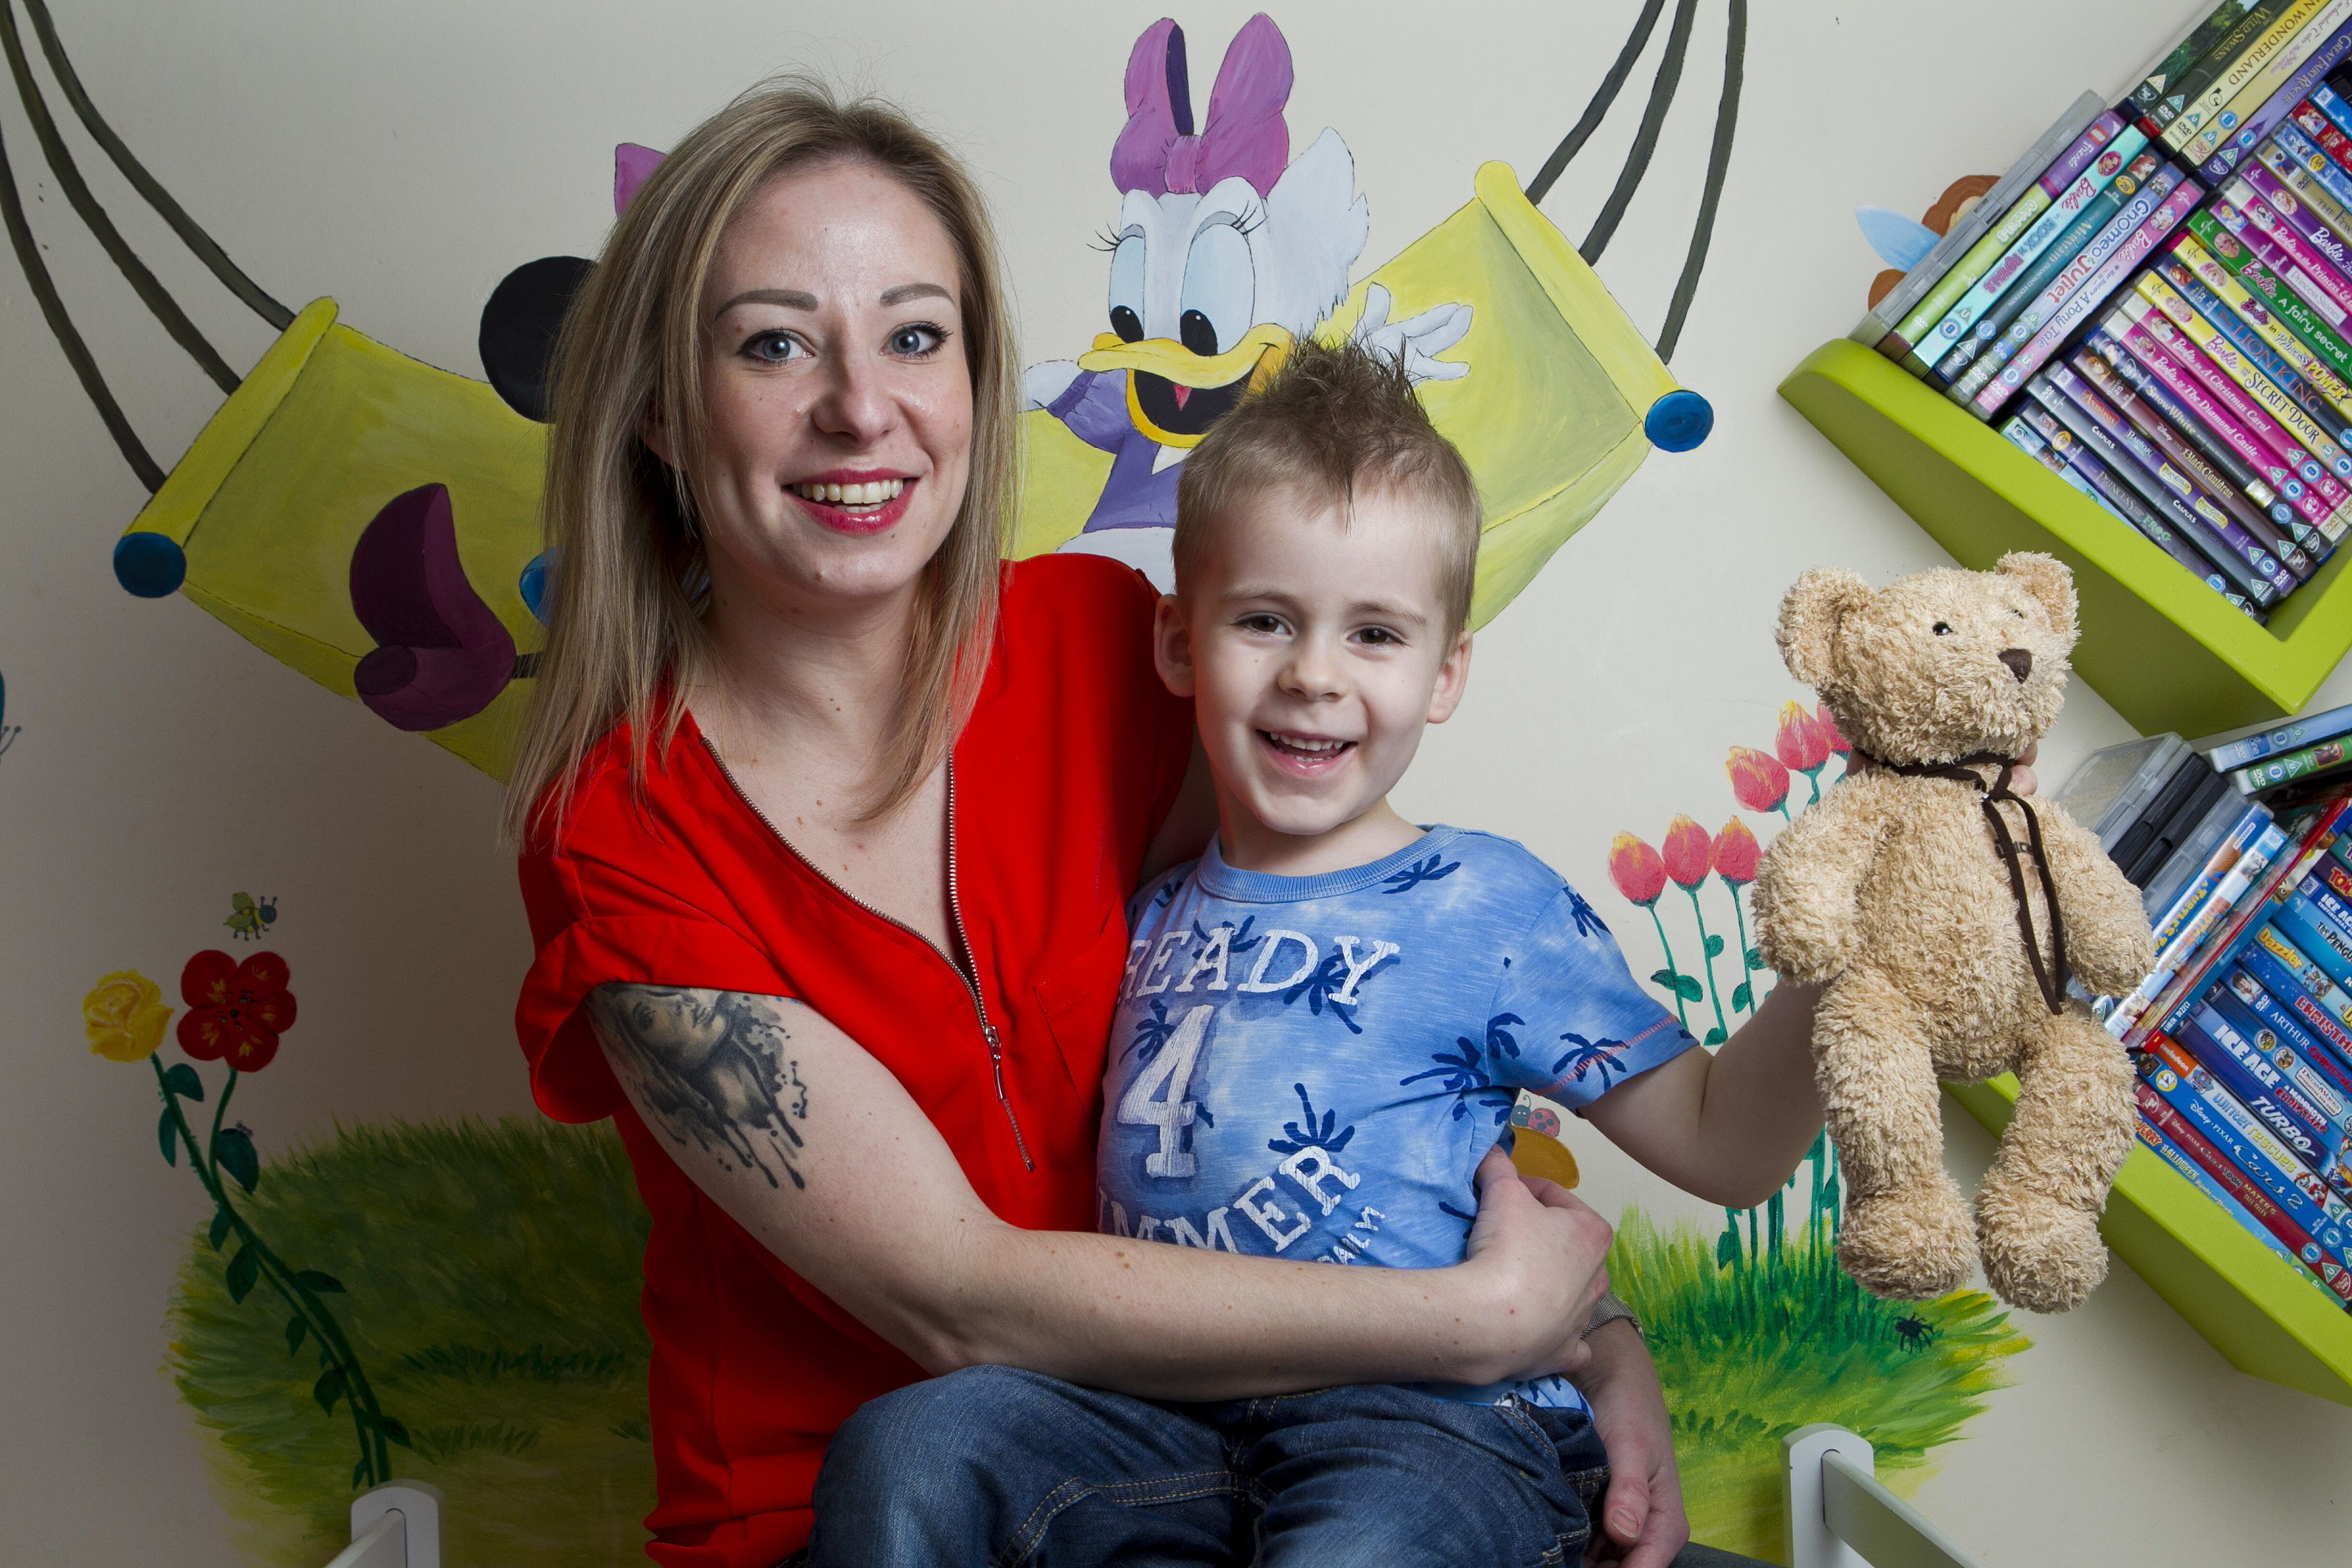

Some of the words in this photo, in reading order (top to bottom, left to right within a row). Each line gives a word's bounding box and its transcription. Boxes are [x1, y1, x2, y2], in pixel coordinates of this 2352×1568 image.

[2239, 4, 2270, 34] WILD
[2211, 29, 2245, 62] SWANS
[2228, 9, 2304, 86] WONDERLAND
[2090, 128, 2105, 142] LEGO
[2065, 140, 2094, 169] Friends
[2059, 178, 2096, 215] Barbie
[2120, 181, 2130, 191] 28
[2295, 174, 2308, 188] DVD
[2316, 199, 2334, 216] THE
[2023, 218, 2056, 250] ROCK
[2047, 219, 2091, 264] MERMAID
[2115, 229, 2152, 266] Barbie
[2310, 226, 2348, 264] Barbie
[1982, 252, 2023, 293] ROYALS
[2025, 262, 2051, 287] DIAMOND
[2274, 226, 2300, 252] Barbie
[2310, 263, 2341, 293] Princess
[2339, 290, 2351, 302] &
[2007, 285, 2028, 306] EDITION
[2054, 299, 2083, 328] Pony
[2079, 292, 2091, 304] A
[2197, 292, 2206, 301] 32
[2242, 258, 2283, 298] Barbie
[2278, 296, 2289, 307] A
[2286, 303, 2316, 333] fairy
[2314, 329, 2348, 363] secret
[2290, 270, 2319, 299] Princess
[2316, 295, 2341, 320] Stories
[2035, 324, 2060, 349] Tale
[2242, 298, 2272, 327] Barbie
[2274, 331, 2310, 367] Princess
[2306, 360, 2347, 401] POWER
[2172, 338, 2199, 364] Barbie
[2202, 367, 2212, 376] A
[2209, 373, 2248, 412] Christmas
[2246, 409, 2271, 433] Carol
[2231, 325, 2277, 369] LION
[2275, 366, 2322, 412] KING
[2040, 385, 2053, 398] DVD
[2114, 385, 2123, 395] 25
[2154, 355, 2180, 381] Barbie
[2184, 385, 2201, 402] The
[2199, 399, 2235, 435] Diamond
[2233, 431, 2259, 457] Castle
[2205, 335, 2242, 371] Barbie
[2244, 372, 2289, 416] SECRET
[2284, 407, 2322, 443] DOOR
[2082, 391, 2117, 425] ANASTASIA
[2091, 425, 2116, 449] CASPERS
[2155, 422, 2173, 441] Disney
[2181, 447, 2204, 470] Black
[2200, 466, 2234, 499] Cauldron
[2094, 470, 2135, 512] PRINCESS
[2141, 513, 2173, 544] FROG
[2172, 499, 2197, 523] CASPERS
[2322, 516, 2338, 532] DVD
[2272, 569, 2287, 584] DVD
[2248, 738, 2259, 755] one
[2255, 768, 2266, 785] DVD
[2325, 866, 2352, 897] TOM
[2162, 886, 2208, 936] TURTLE'S
[2317, 900, 2347, 929] CONTINENTAL
[2321, 894, 2340, 912] ICE
[2181, 896, 2230, 949] HORTON
[2257, 926, 2305, 973] Dazzler
[2254, 994, 2269, 1009] DVD
[2271, 1010, 2311, 1050] ARTHUR
[2214, 1024, 2250, 1060] ICE
[2242, 1052, 2280, 1088] AGE
[1118, 1005, 1213, 1179] 4
[2158, 1071, 2175, 1088] 12
[2300, 1069, 2342, 1108] DREAMWORKS
[2250, 1093, 2316, 1157] TURBO
[2274, 1085, 2327, 1136] CHRISTMAS
[2288, 1087, 2327, 1126] MAMMOTH
[2213, 1092, 2251, 1130] winter
[2248, 1126, 2297, 1173] rescues
[2136, 1121, 2163, 1148] JERRY
[2160, 1143, 2199, 1182] HALLOWEEN
[2170, 1119, 2186, 1135] Disney
[2186, 1133, 2200, 1147] PIXAR
[2199, 1145, 2224, 1169] Cars
[2221, 1167, 2242, 1188] TOON
[2243, 1183, 2277, 1215] MATER'S
[2186, 1098, 2213, 1124] Disney
[2213, 1124, 2233, 1144] PIXAR
[2231, 1140, 2289, 1197] Cars
[2286, 1193, 2303, 1209] 2
[2244, 1193, 2254, 1204] TALL
[2253, 1203, 2267, 1217] TALES
